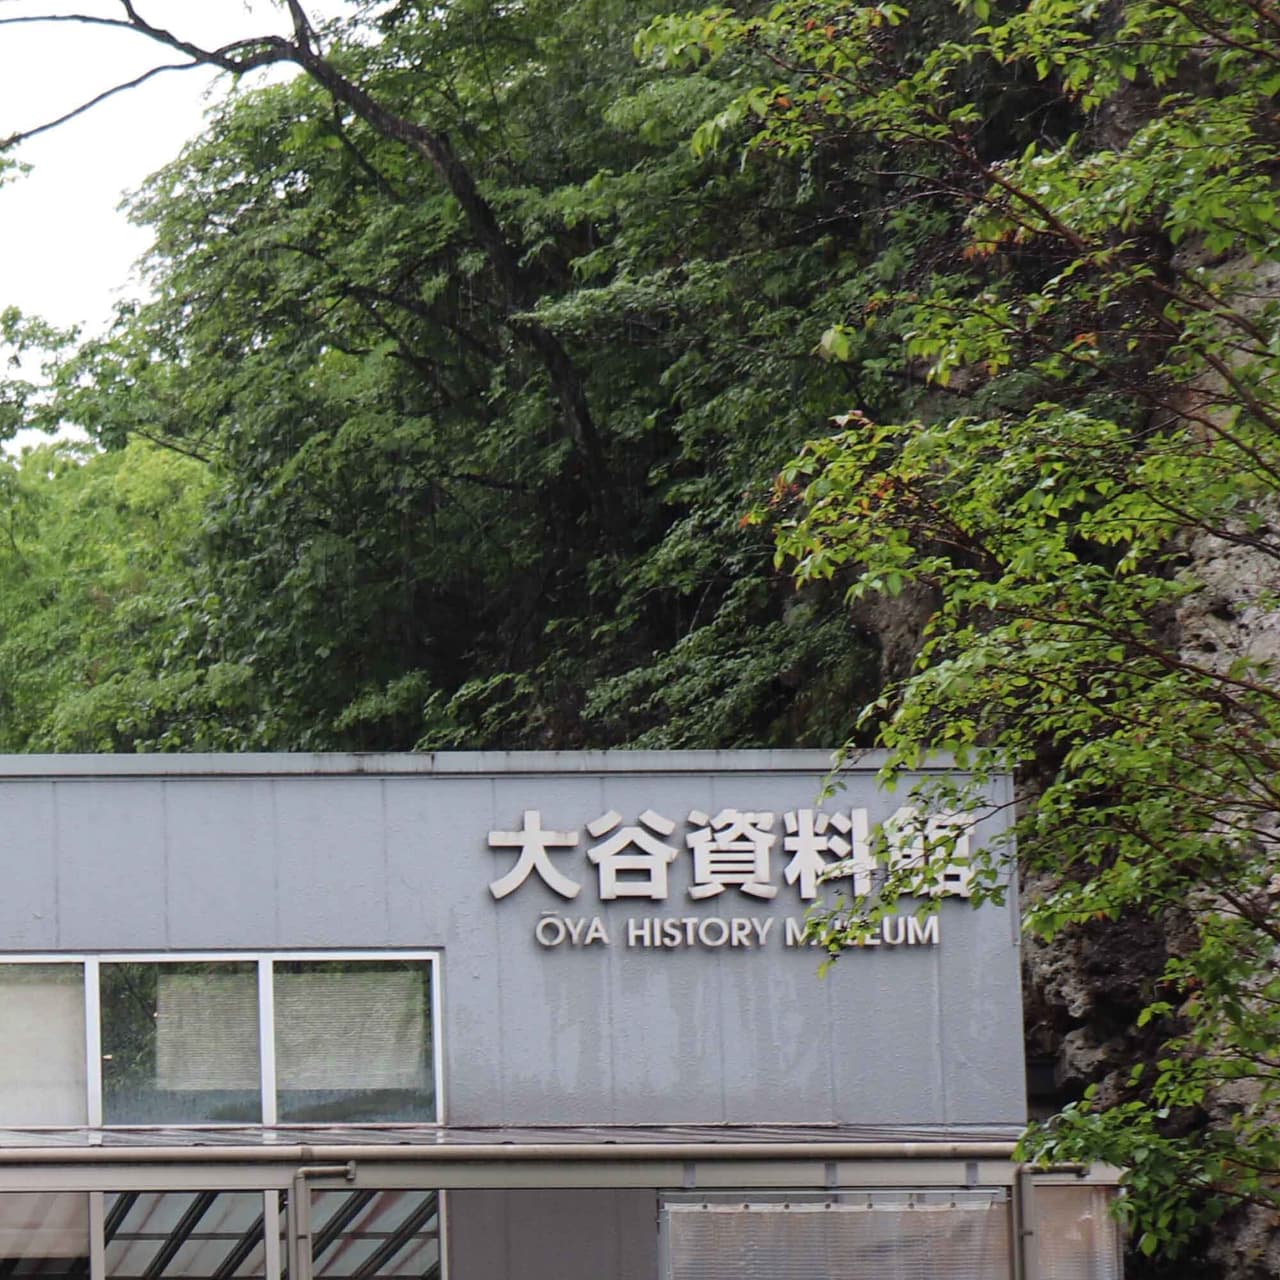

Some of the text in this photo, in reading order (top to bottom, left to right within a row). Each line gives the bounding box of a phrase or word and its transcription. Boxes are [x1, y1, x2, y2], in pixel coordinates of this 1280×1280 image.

[486, 807, 976, 901] 大谷資料館
[627, 916, 774, 947] HISTORY
